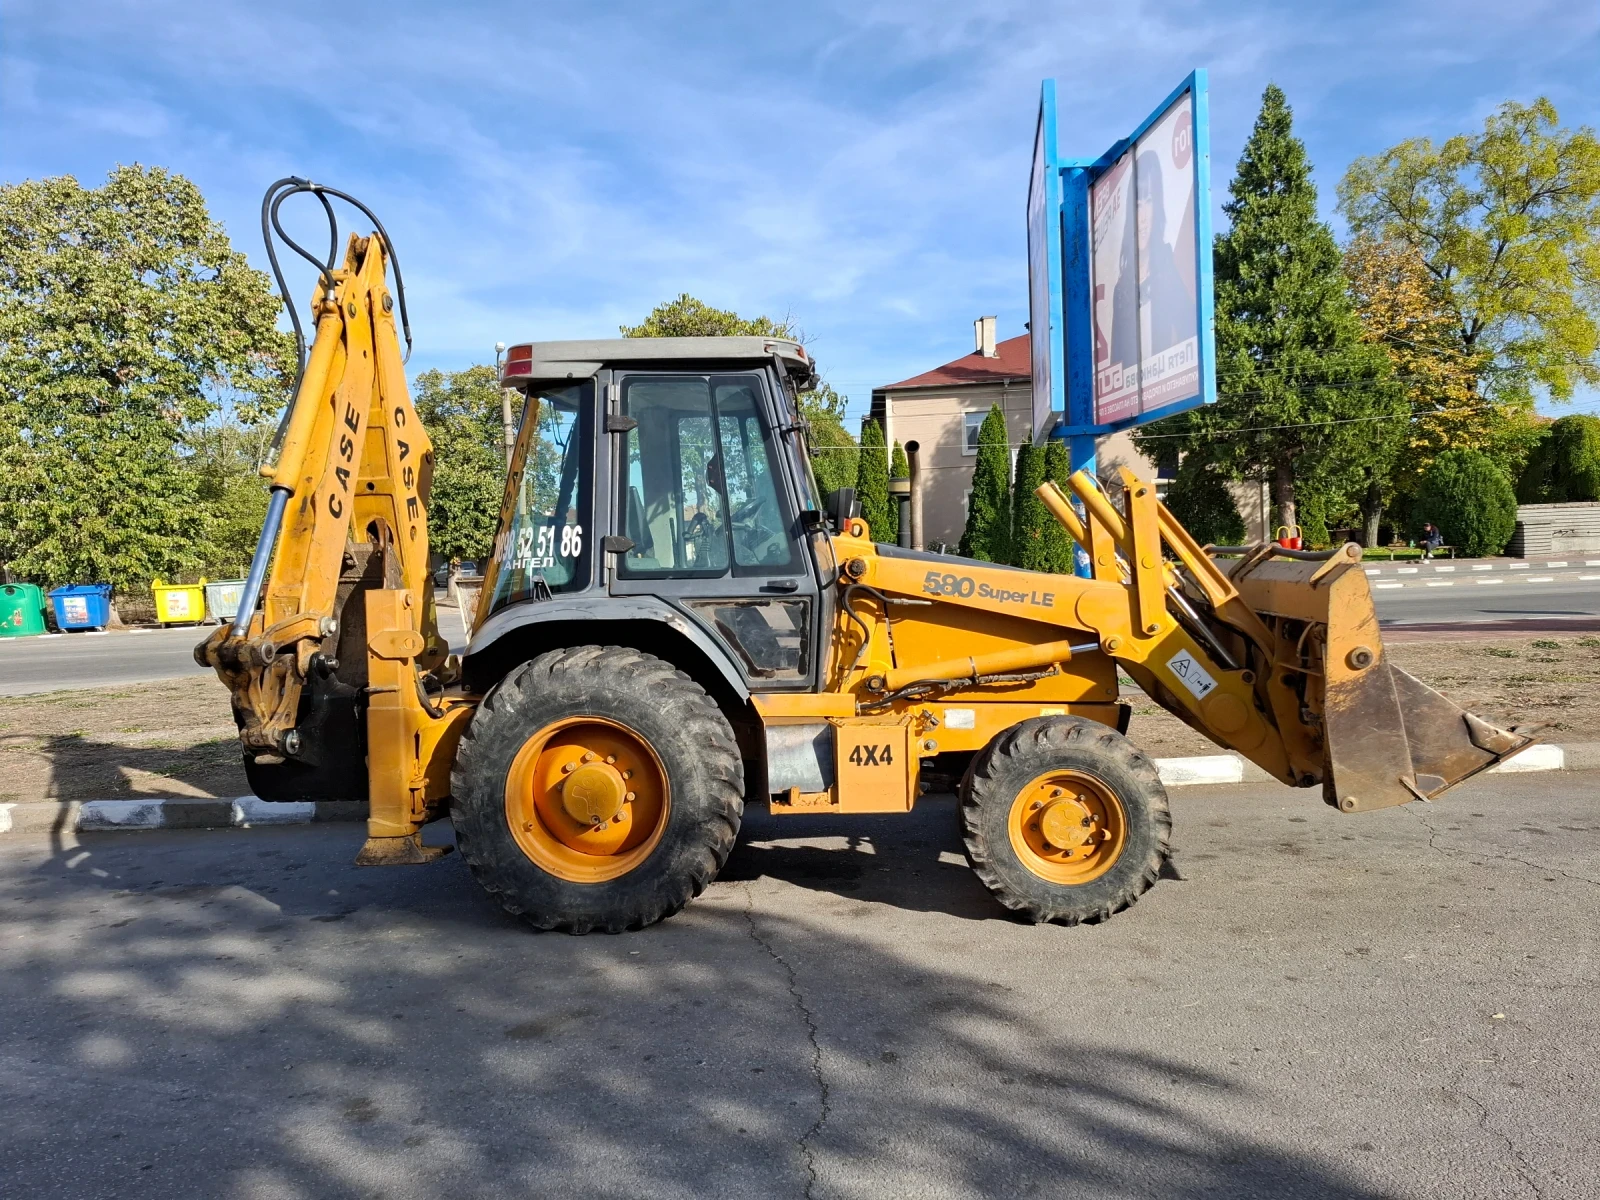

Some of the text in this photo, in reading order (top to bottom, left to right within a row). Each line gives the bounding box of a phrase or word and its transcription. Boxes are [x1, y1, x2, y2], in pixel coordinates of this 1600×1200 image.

[328, 401, 361, 519] CASE
[394, 406, 419, 522] CASE
[517, 526, 534, 559] 52
[536, 525, 556, 557] 51
[560, 524, 583, 558] 86
[503, 557, 554, 571] АНГЕЛ
[923, 571, 1055, 607] 580 Super LE
[849, 744, 893, 766] 4X4
